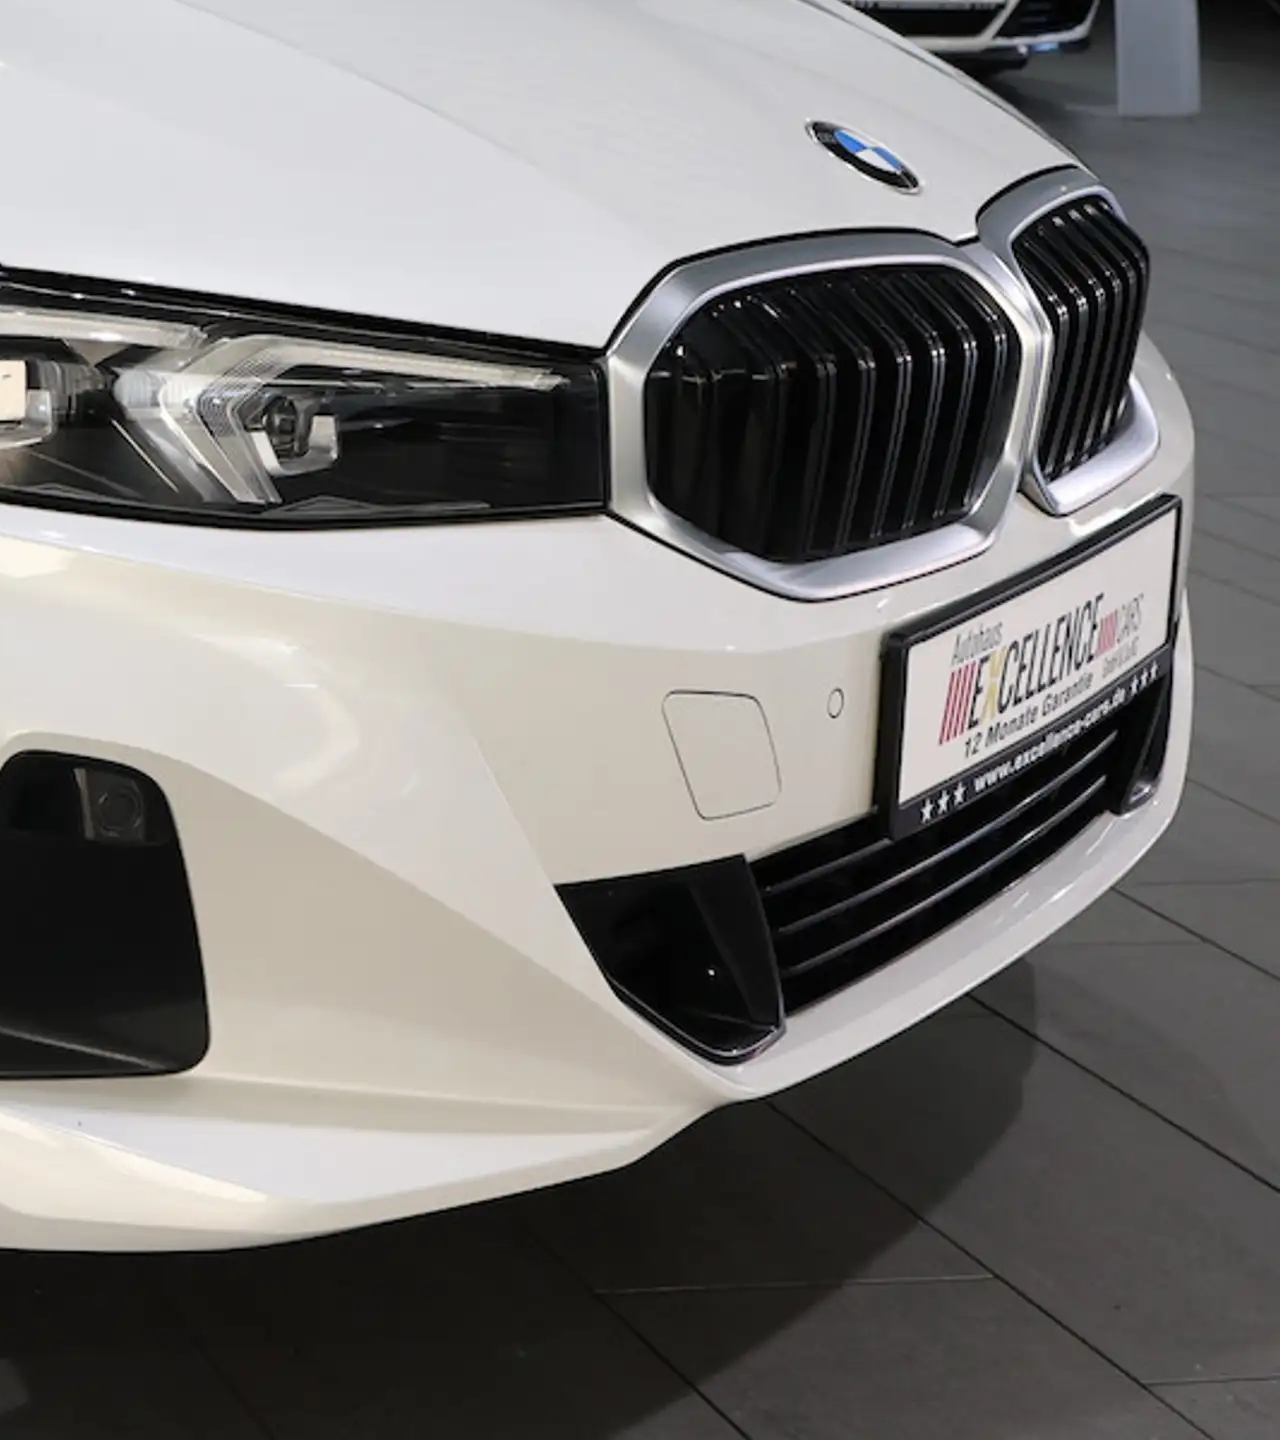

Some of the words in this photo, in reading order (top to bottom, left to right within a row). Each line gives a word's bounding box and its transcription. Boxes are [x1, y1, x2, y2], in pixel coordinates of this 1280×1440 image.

[951, 622, 1003, 665] Autohaus
[968, 592, 1104, 730] EXCELLENCE
[964, 730, 981, 759] 12
[985, 704, 1039, 748] Monate
[1042, 671, 1094, 716] Garantie
[973, 687, 1126, 793] www.excellence-cars.de
